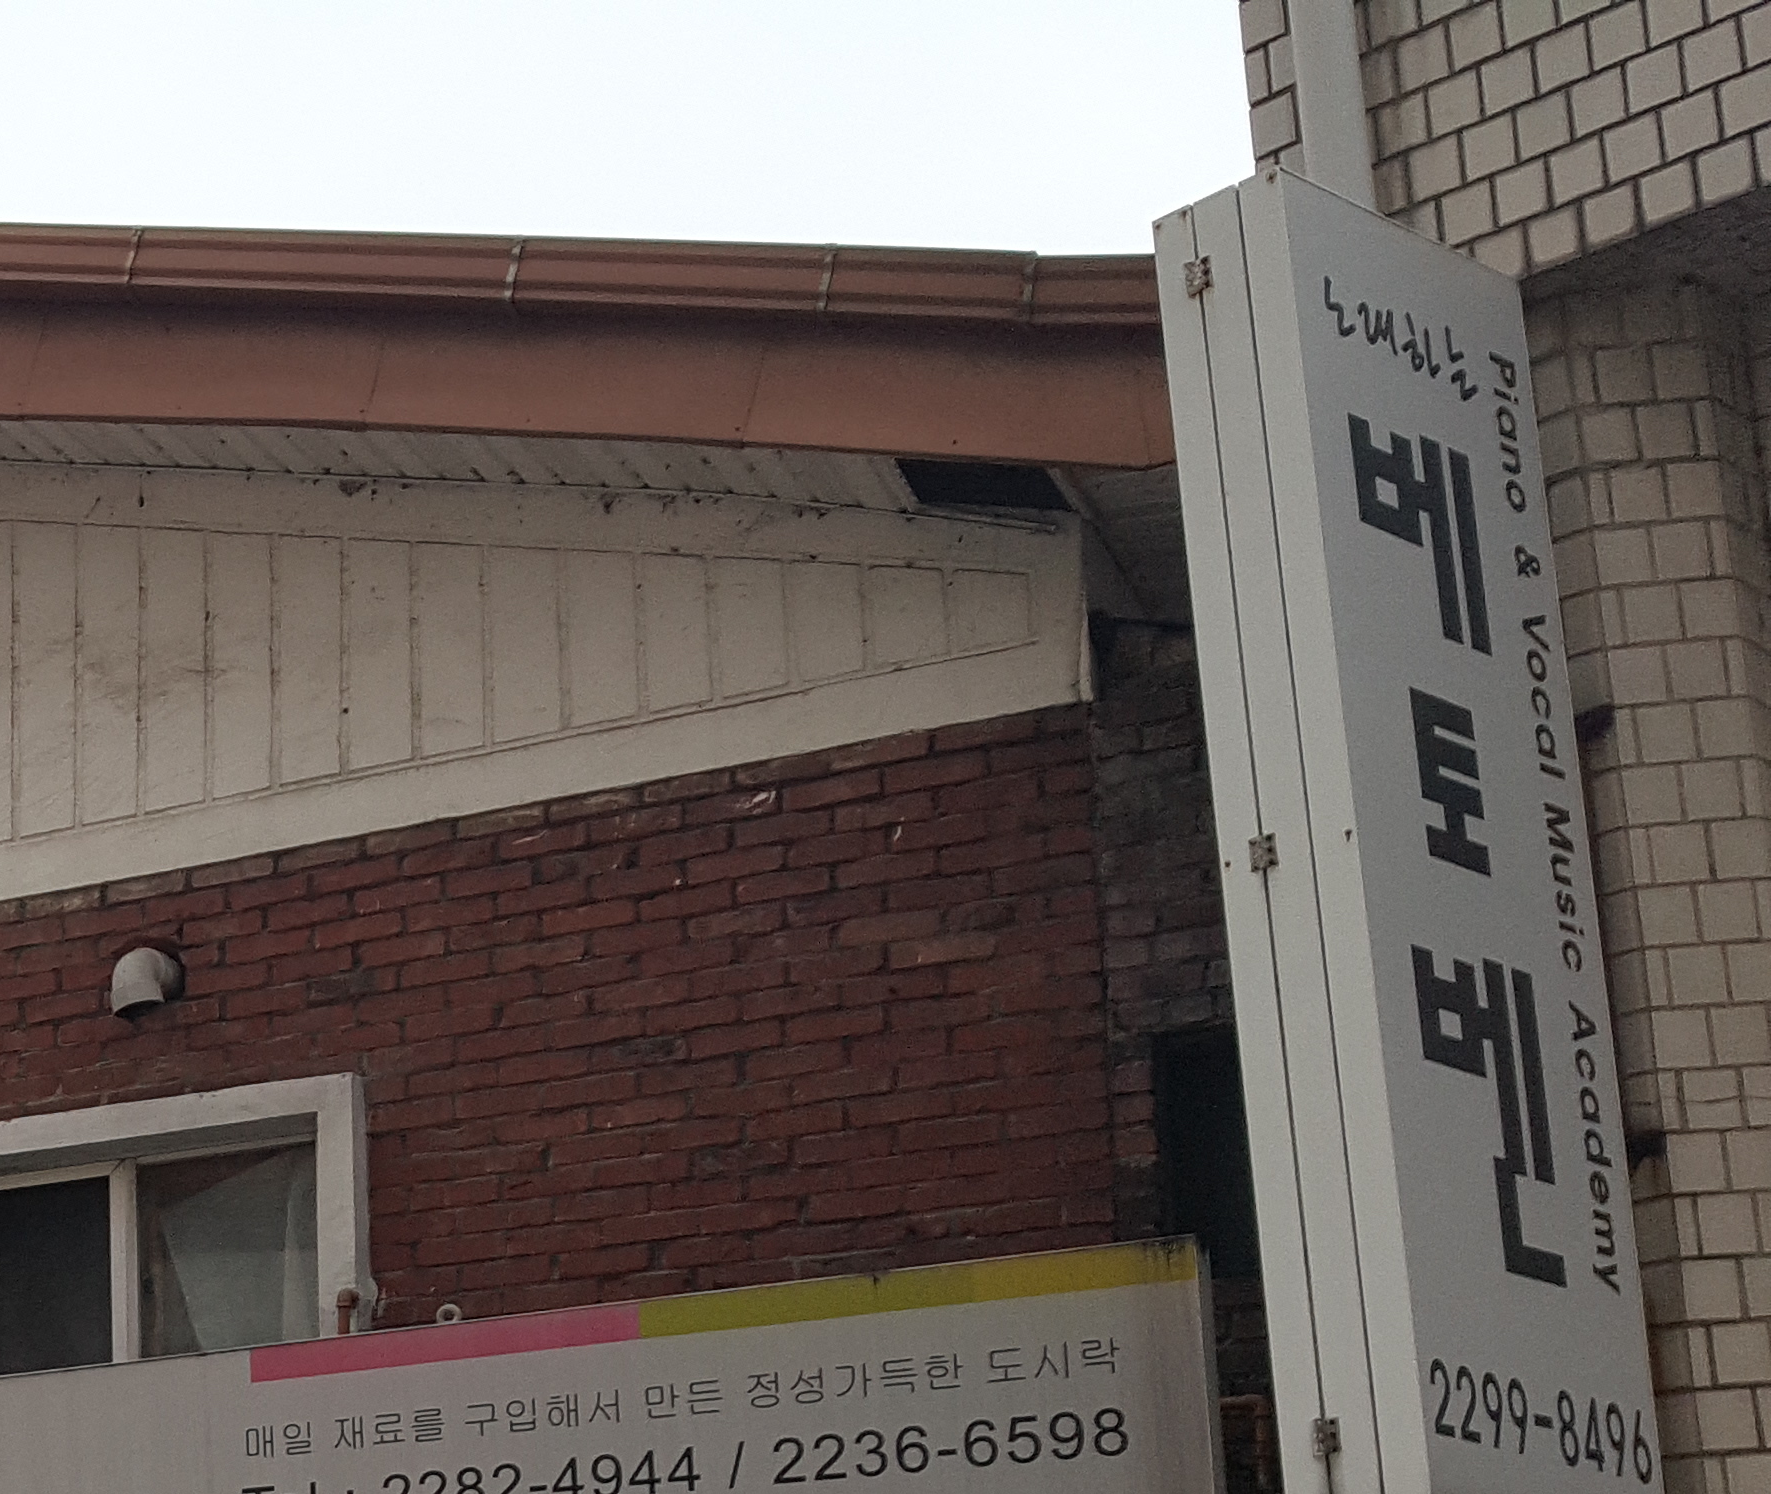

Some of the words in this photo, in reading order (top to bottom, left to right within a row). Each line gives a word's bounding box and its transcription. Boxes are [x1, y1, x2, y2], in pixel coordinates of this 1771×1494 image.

[1323, 275, 1479, 402] 노래하는
[1488, 350, 1526, 513] Piano
[1514, 543, 1543, 579] &
[1521, 614, 1566, 780] Vocal
[1347, 412, 1567, 1288] 베토벤
[1543, 801, 1584, 974] Music
[1567, 1001, 1621, 1297] Academy
[244, 1421, 315, 1459] 매일
[332, 1401, 447, 1452] 재료를
[464, 1387, 624, 1438] 구입해서
[643, 1378, 723, 1419] 만든
[746, 1350, 963, 1411] 정성가득한
[985, 1335, 1121, 1384] 도시락
[772, 1405, 1130, 1486] 2236-6598
[1429, 1357, 1653, 1486] 2299-8496
